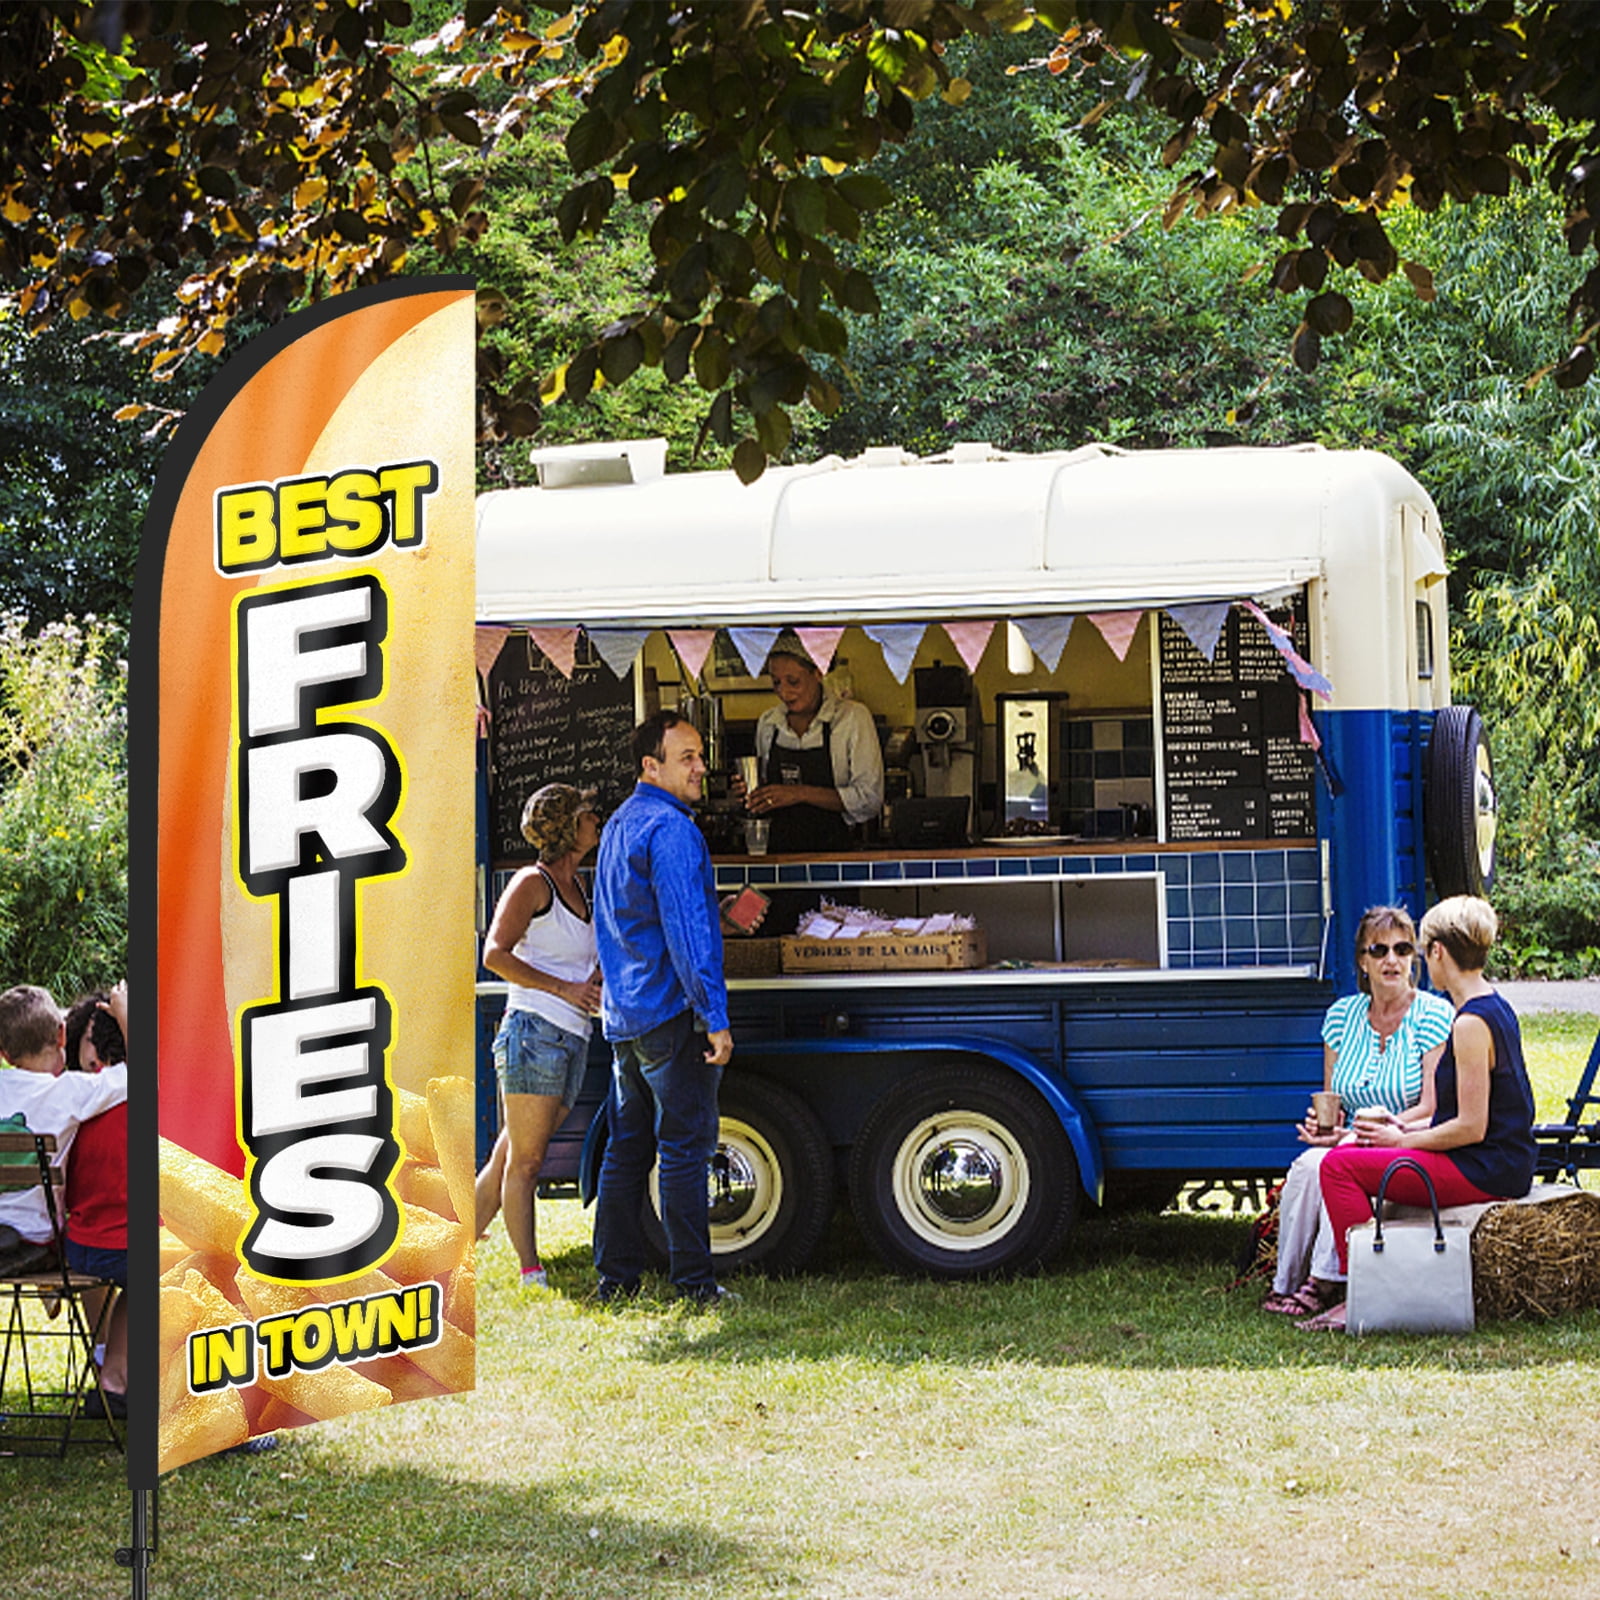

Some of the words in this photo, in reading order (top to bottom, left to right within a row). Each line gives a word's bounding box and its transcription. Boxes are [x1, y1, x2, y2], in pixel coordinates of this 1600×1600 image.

[216, 461, 436, 573] BEST
[242, 580, 398, 1270] FRIES
[857, 944, 875, 957] DE
[880, 944, 897, 956] LA
[190, 1325, 252, 1390] IN
[258, 1285, 438, 1375] TOWN!
